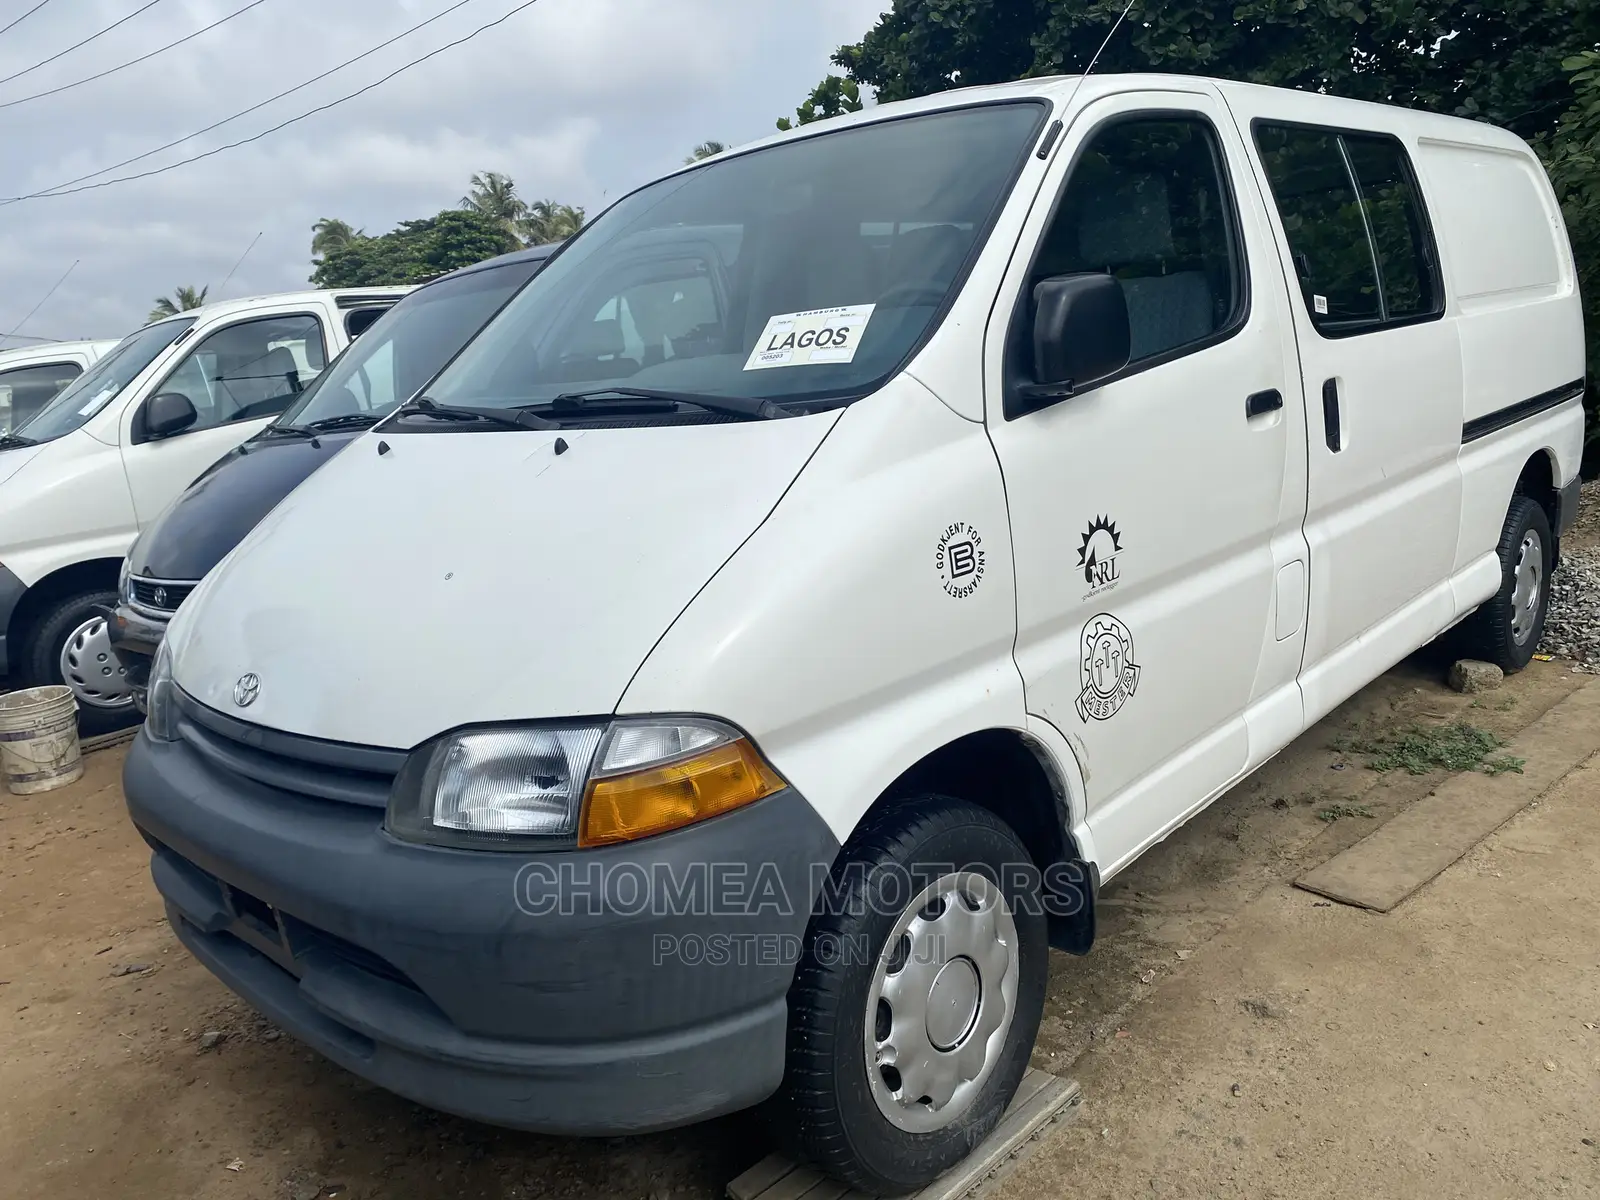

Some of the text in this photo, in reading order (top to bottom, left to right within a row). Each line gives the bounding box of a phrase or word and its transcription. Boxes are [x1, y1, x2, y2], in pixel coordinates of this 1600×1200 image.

[767, 327, 850, 351] LAGOS
[936, 522, 985, 598] GODKJENT FOR ANSVARSRETT
[1090, 557, 1120, 589] NRL
[1085, 672, 1132, 716] MESTER
